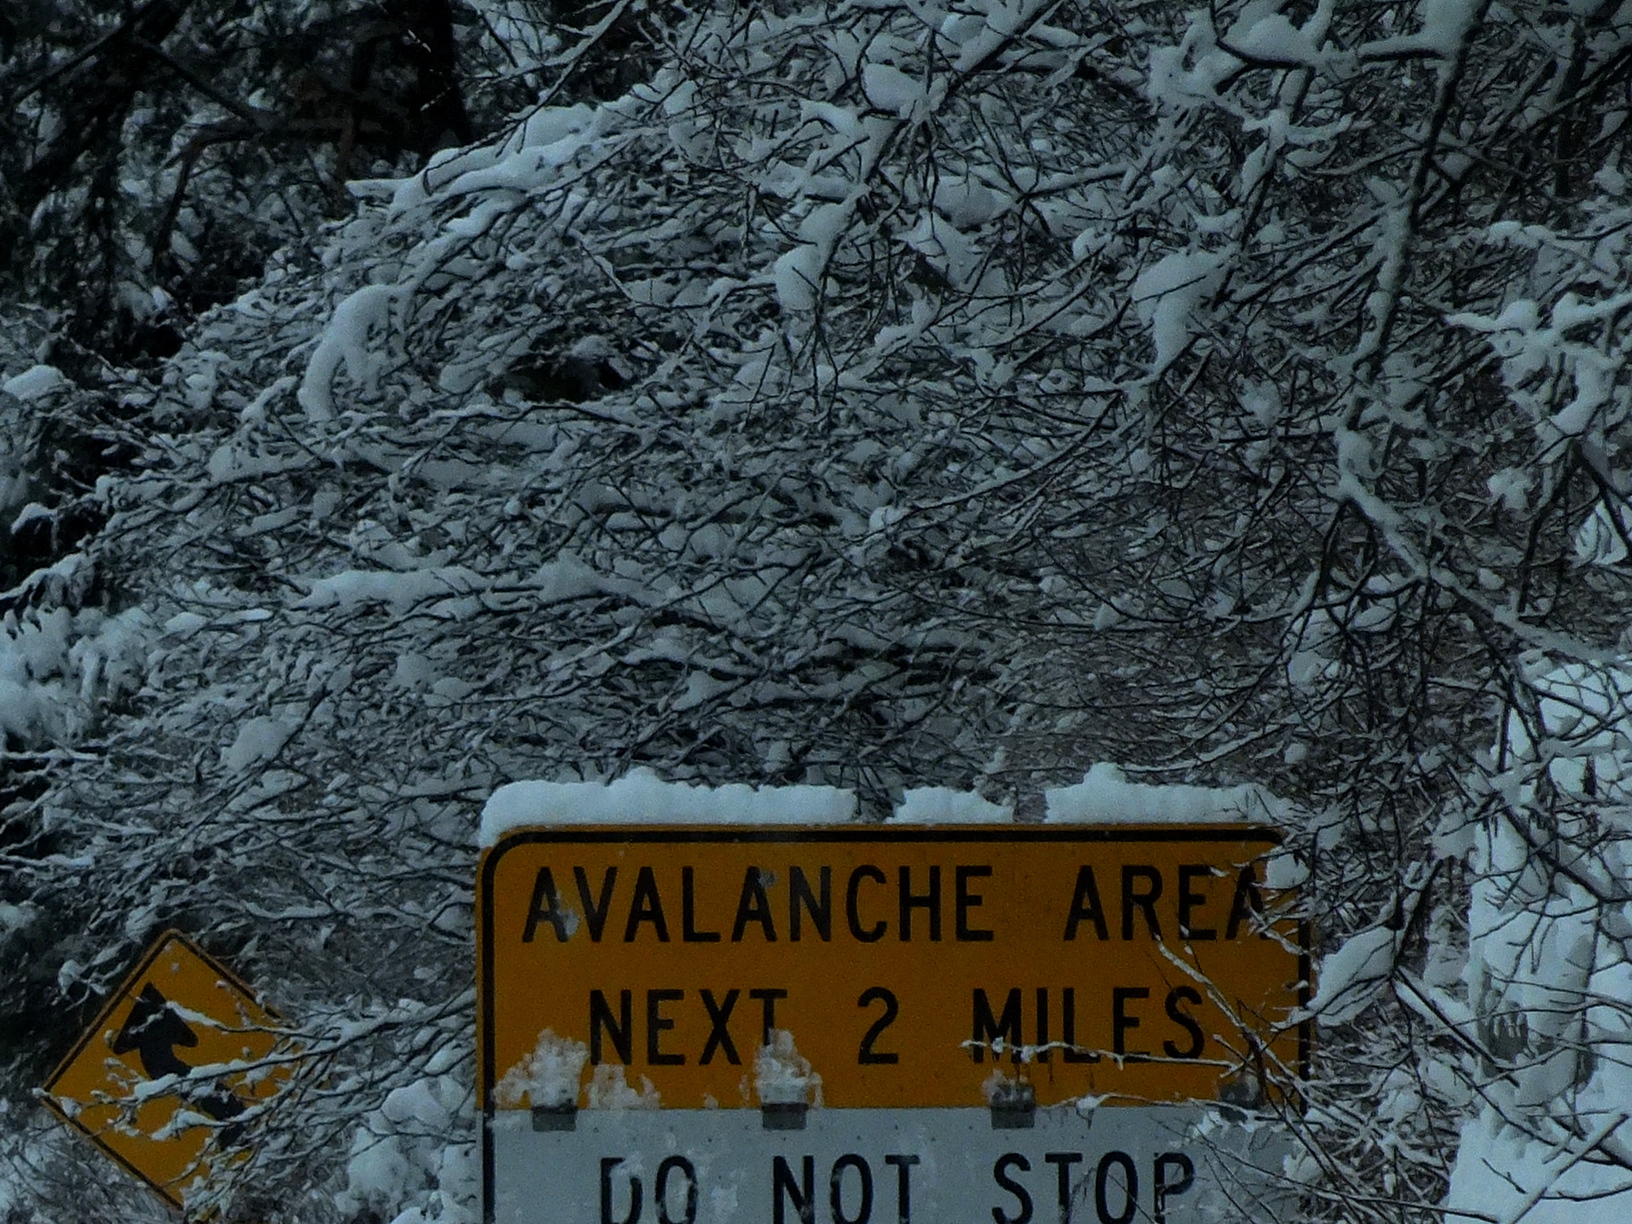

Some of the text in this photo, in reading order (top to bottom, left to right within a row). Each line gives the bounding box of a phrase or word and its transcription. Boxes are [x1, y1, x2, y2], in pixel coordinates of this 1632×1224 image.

[521, 863, 1269, 943] AVALANCHE AREA
[588, 985, 1207, 1066] NEXT 2 MILES
